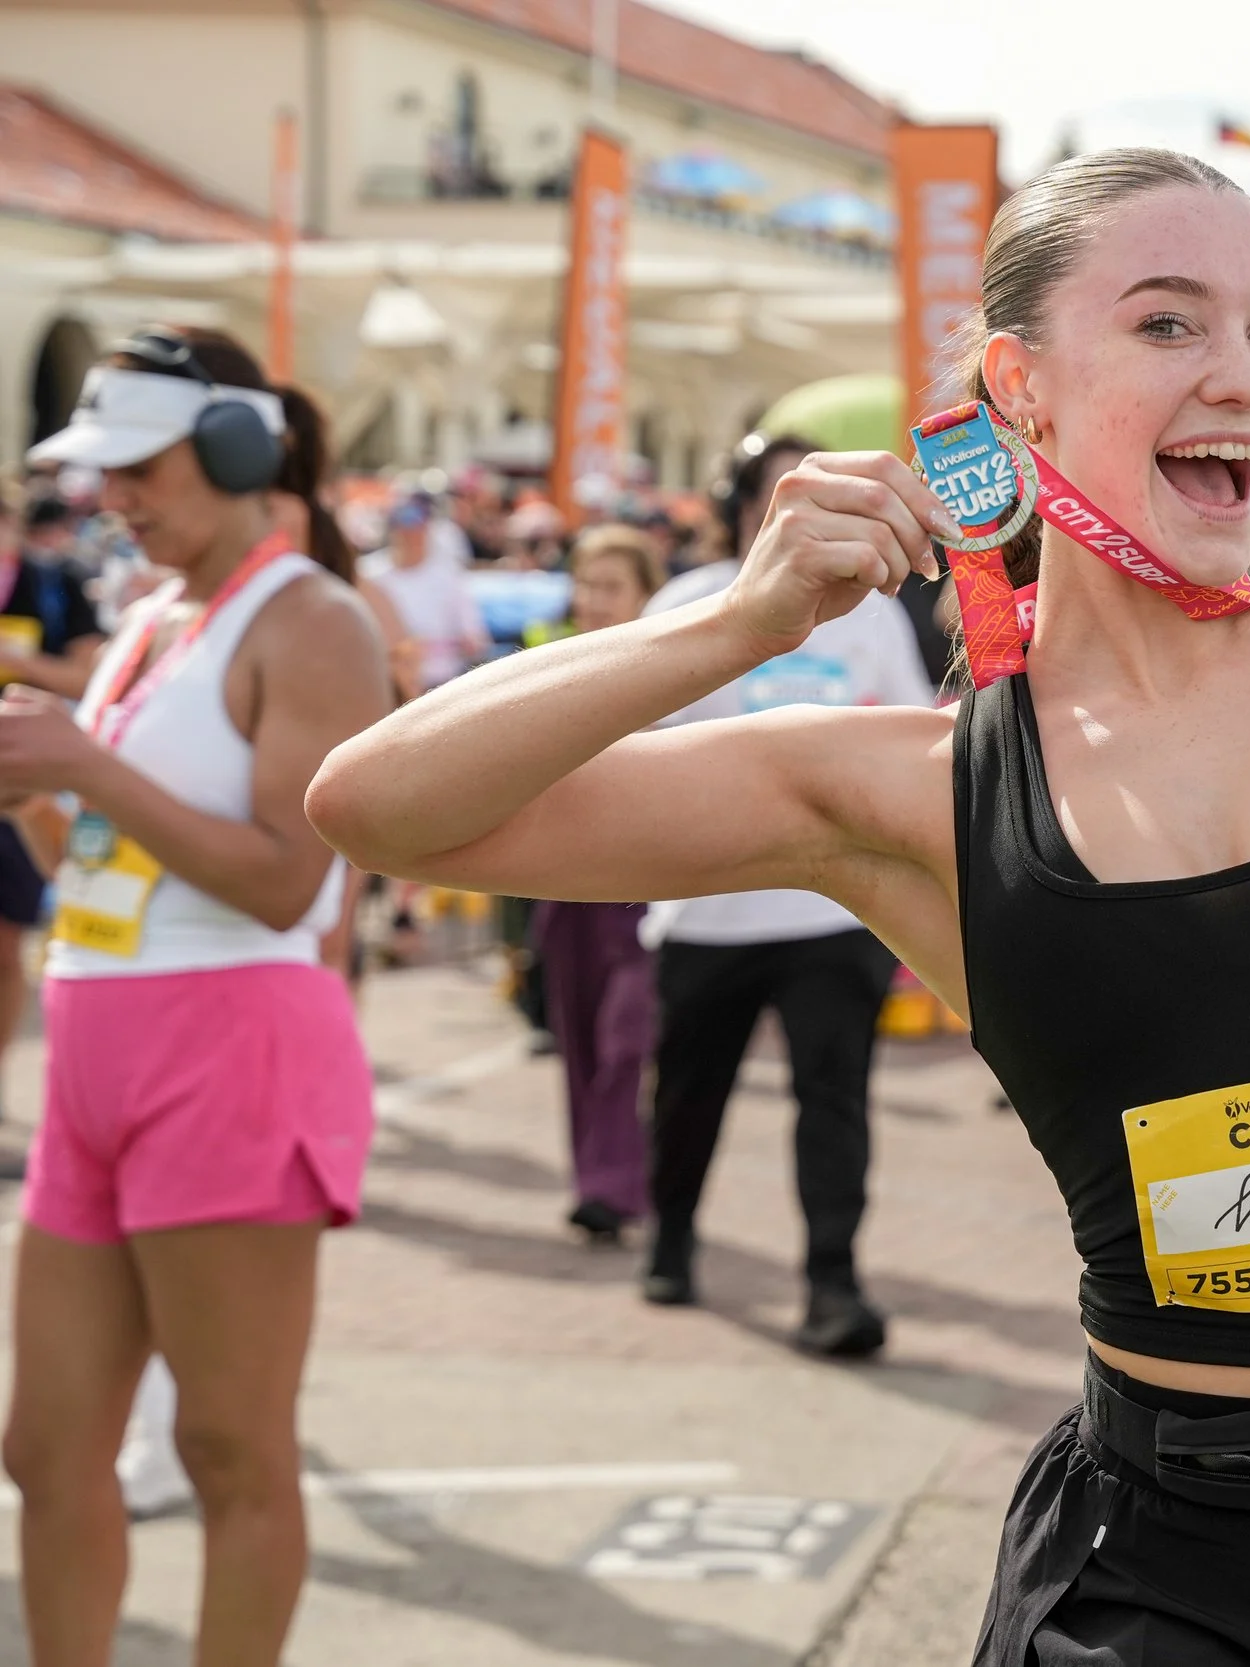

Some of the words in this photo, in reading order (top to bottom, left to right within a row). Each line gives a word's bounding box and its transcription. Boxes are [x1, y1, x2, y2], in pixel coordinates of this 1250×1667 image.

[947, 444, 990, 467] Voltaren
[1152, 1183, 1171, 1207] NAME
[1160, 1189, 1179, 1212] HERE
